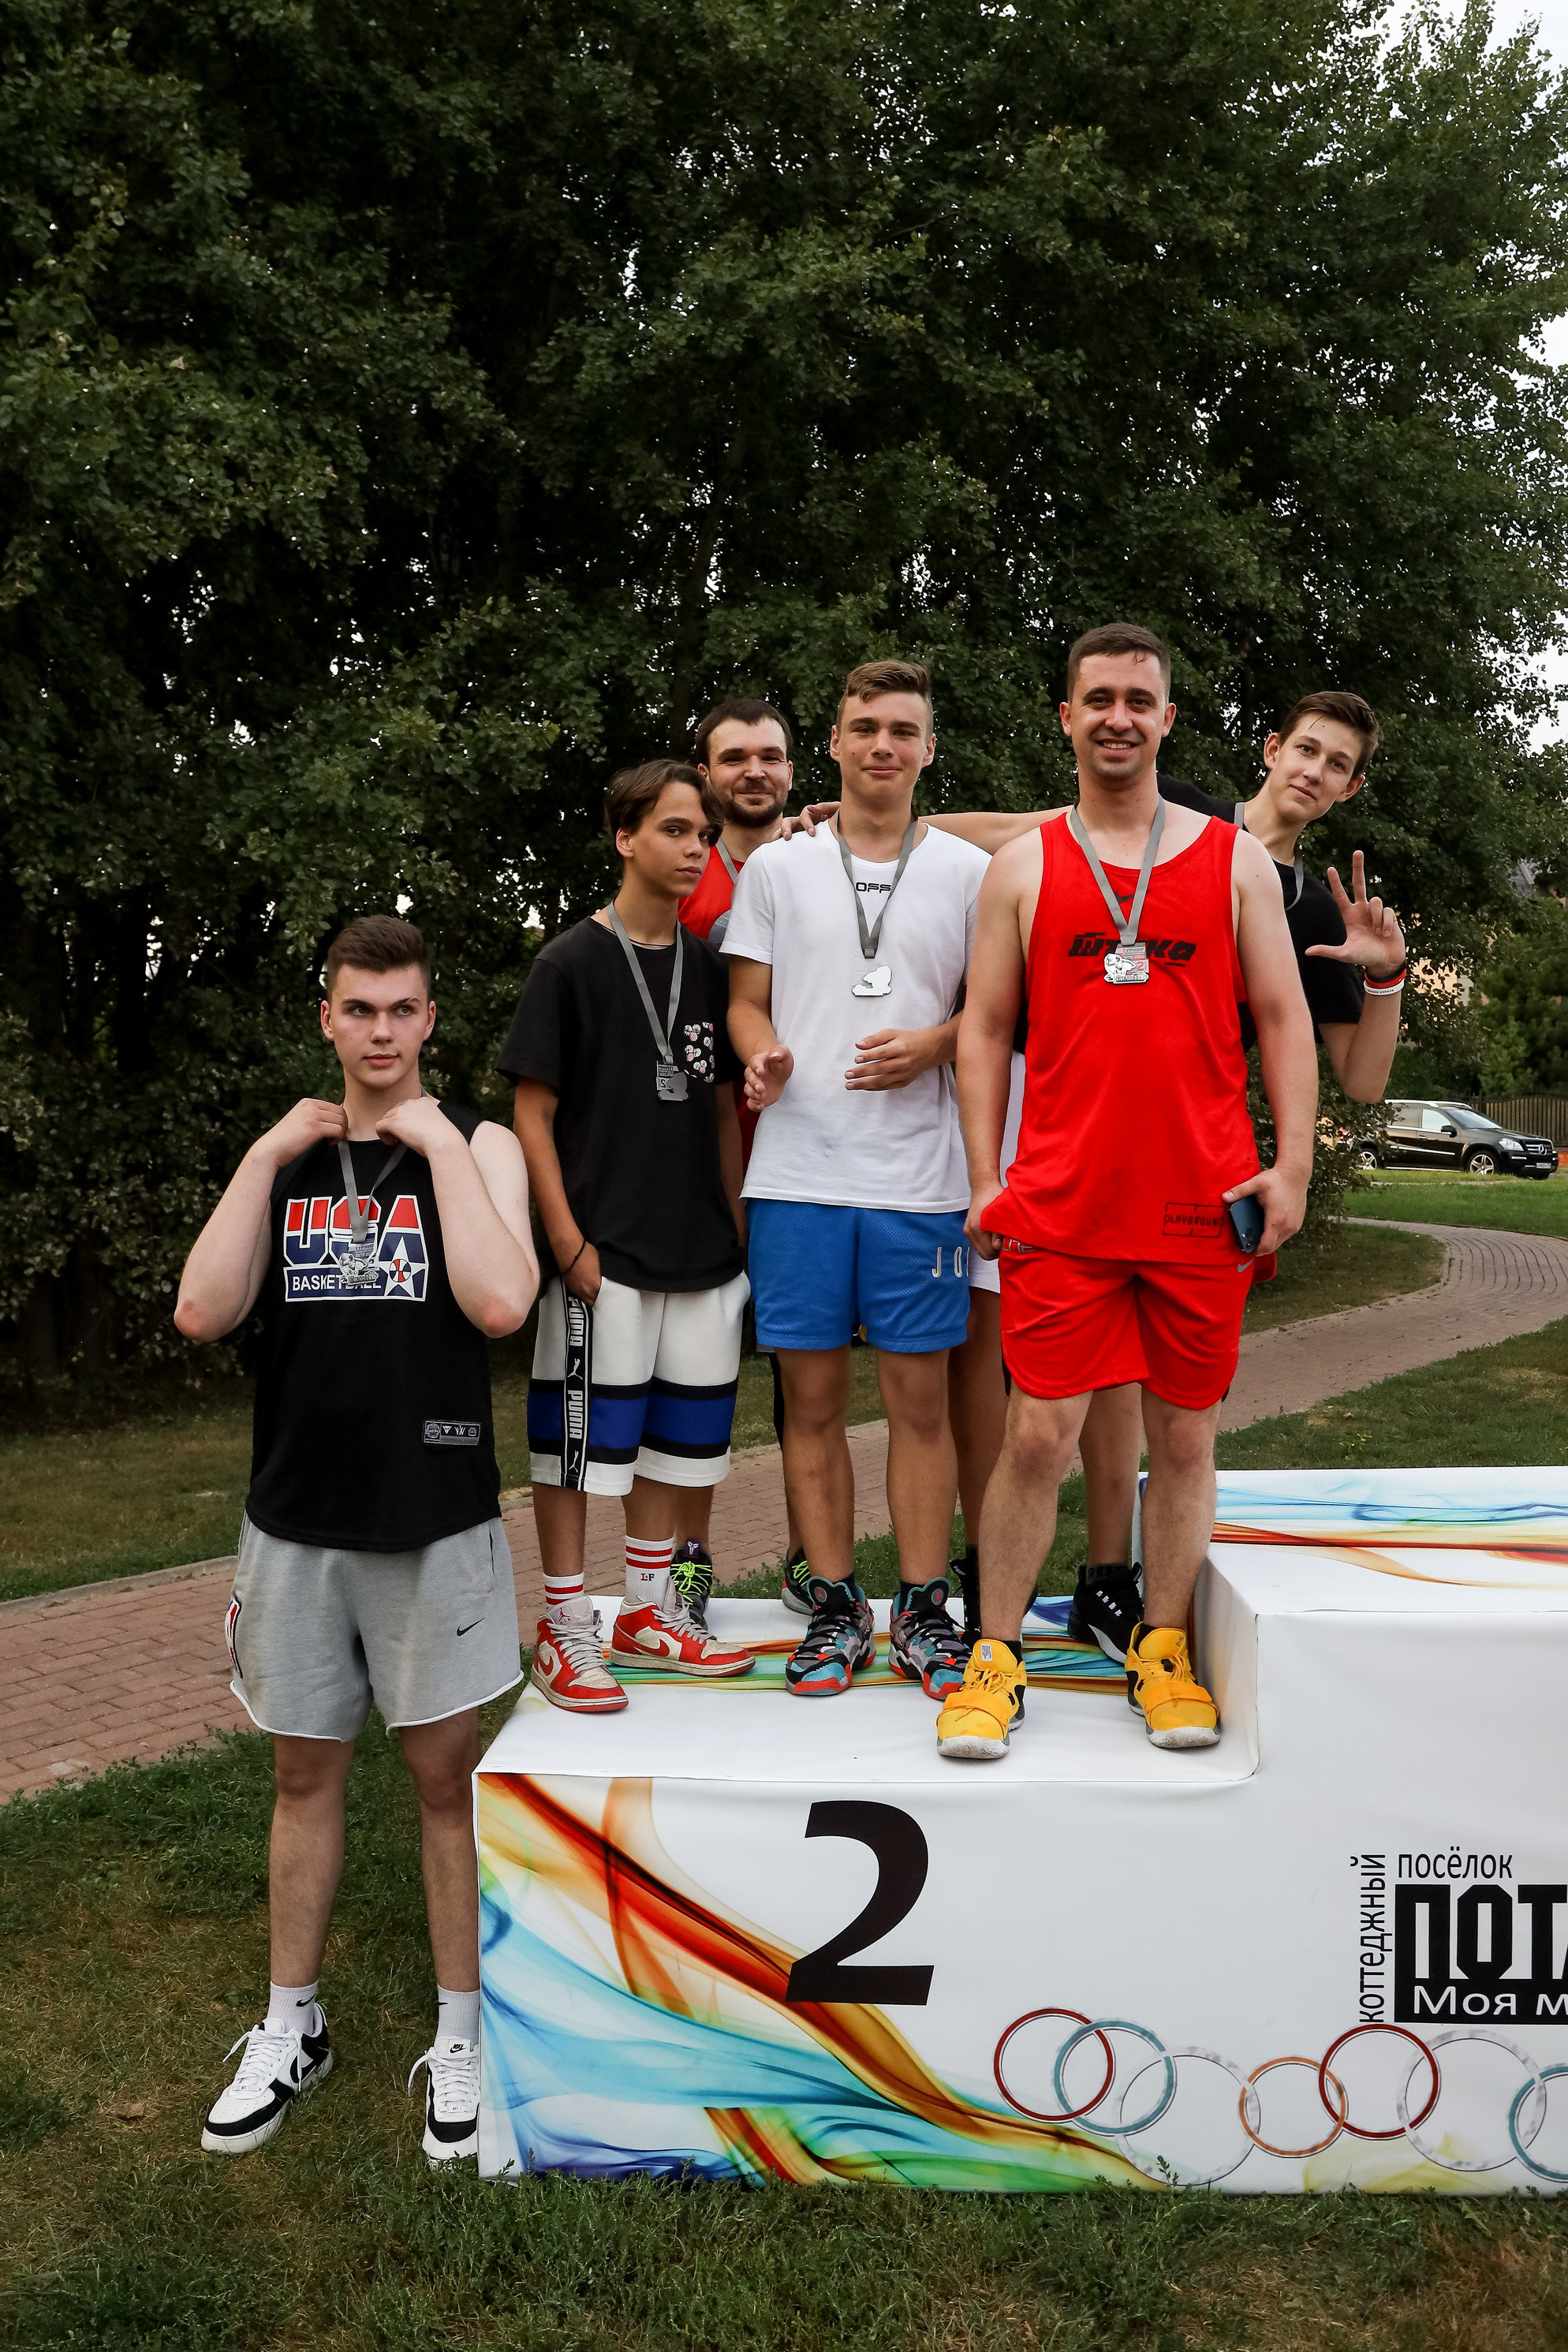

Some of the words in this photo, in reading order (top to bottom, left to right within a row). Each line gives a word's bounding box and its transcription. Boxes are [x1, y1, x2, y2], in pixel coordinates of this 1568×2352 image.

[856, 882, 891, 893] OFF
[1137, 961, 1144, 970] 2
[283, 1195, 429, 1267] USA
[931, 1246, 970, 1278] JO
[292, 1273, 382, 1292] BASKET
[567, 1389, 584, 1439] PUMA
[1398, 1846, 1513, 1879] посёлок
[786, 1800, 935, 2006] 2
[1350, 1854, 1393, 2023] коттеджный
[1394, 1883, 1568, 1981] ПОТ
[1413, 1985, 1517, 2015] Моя
